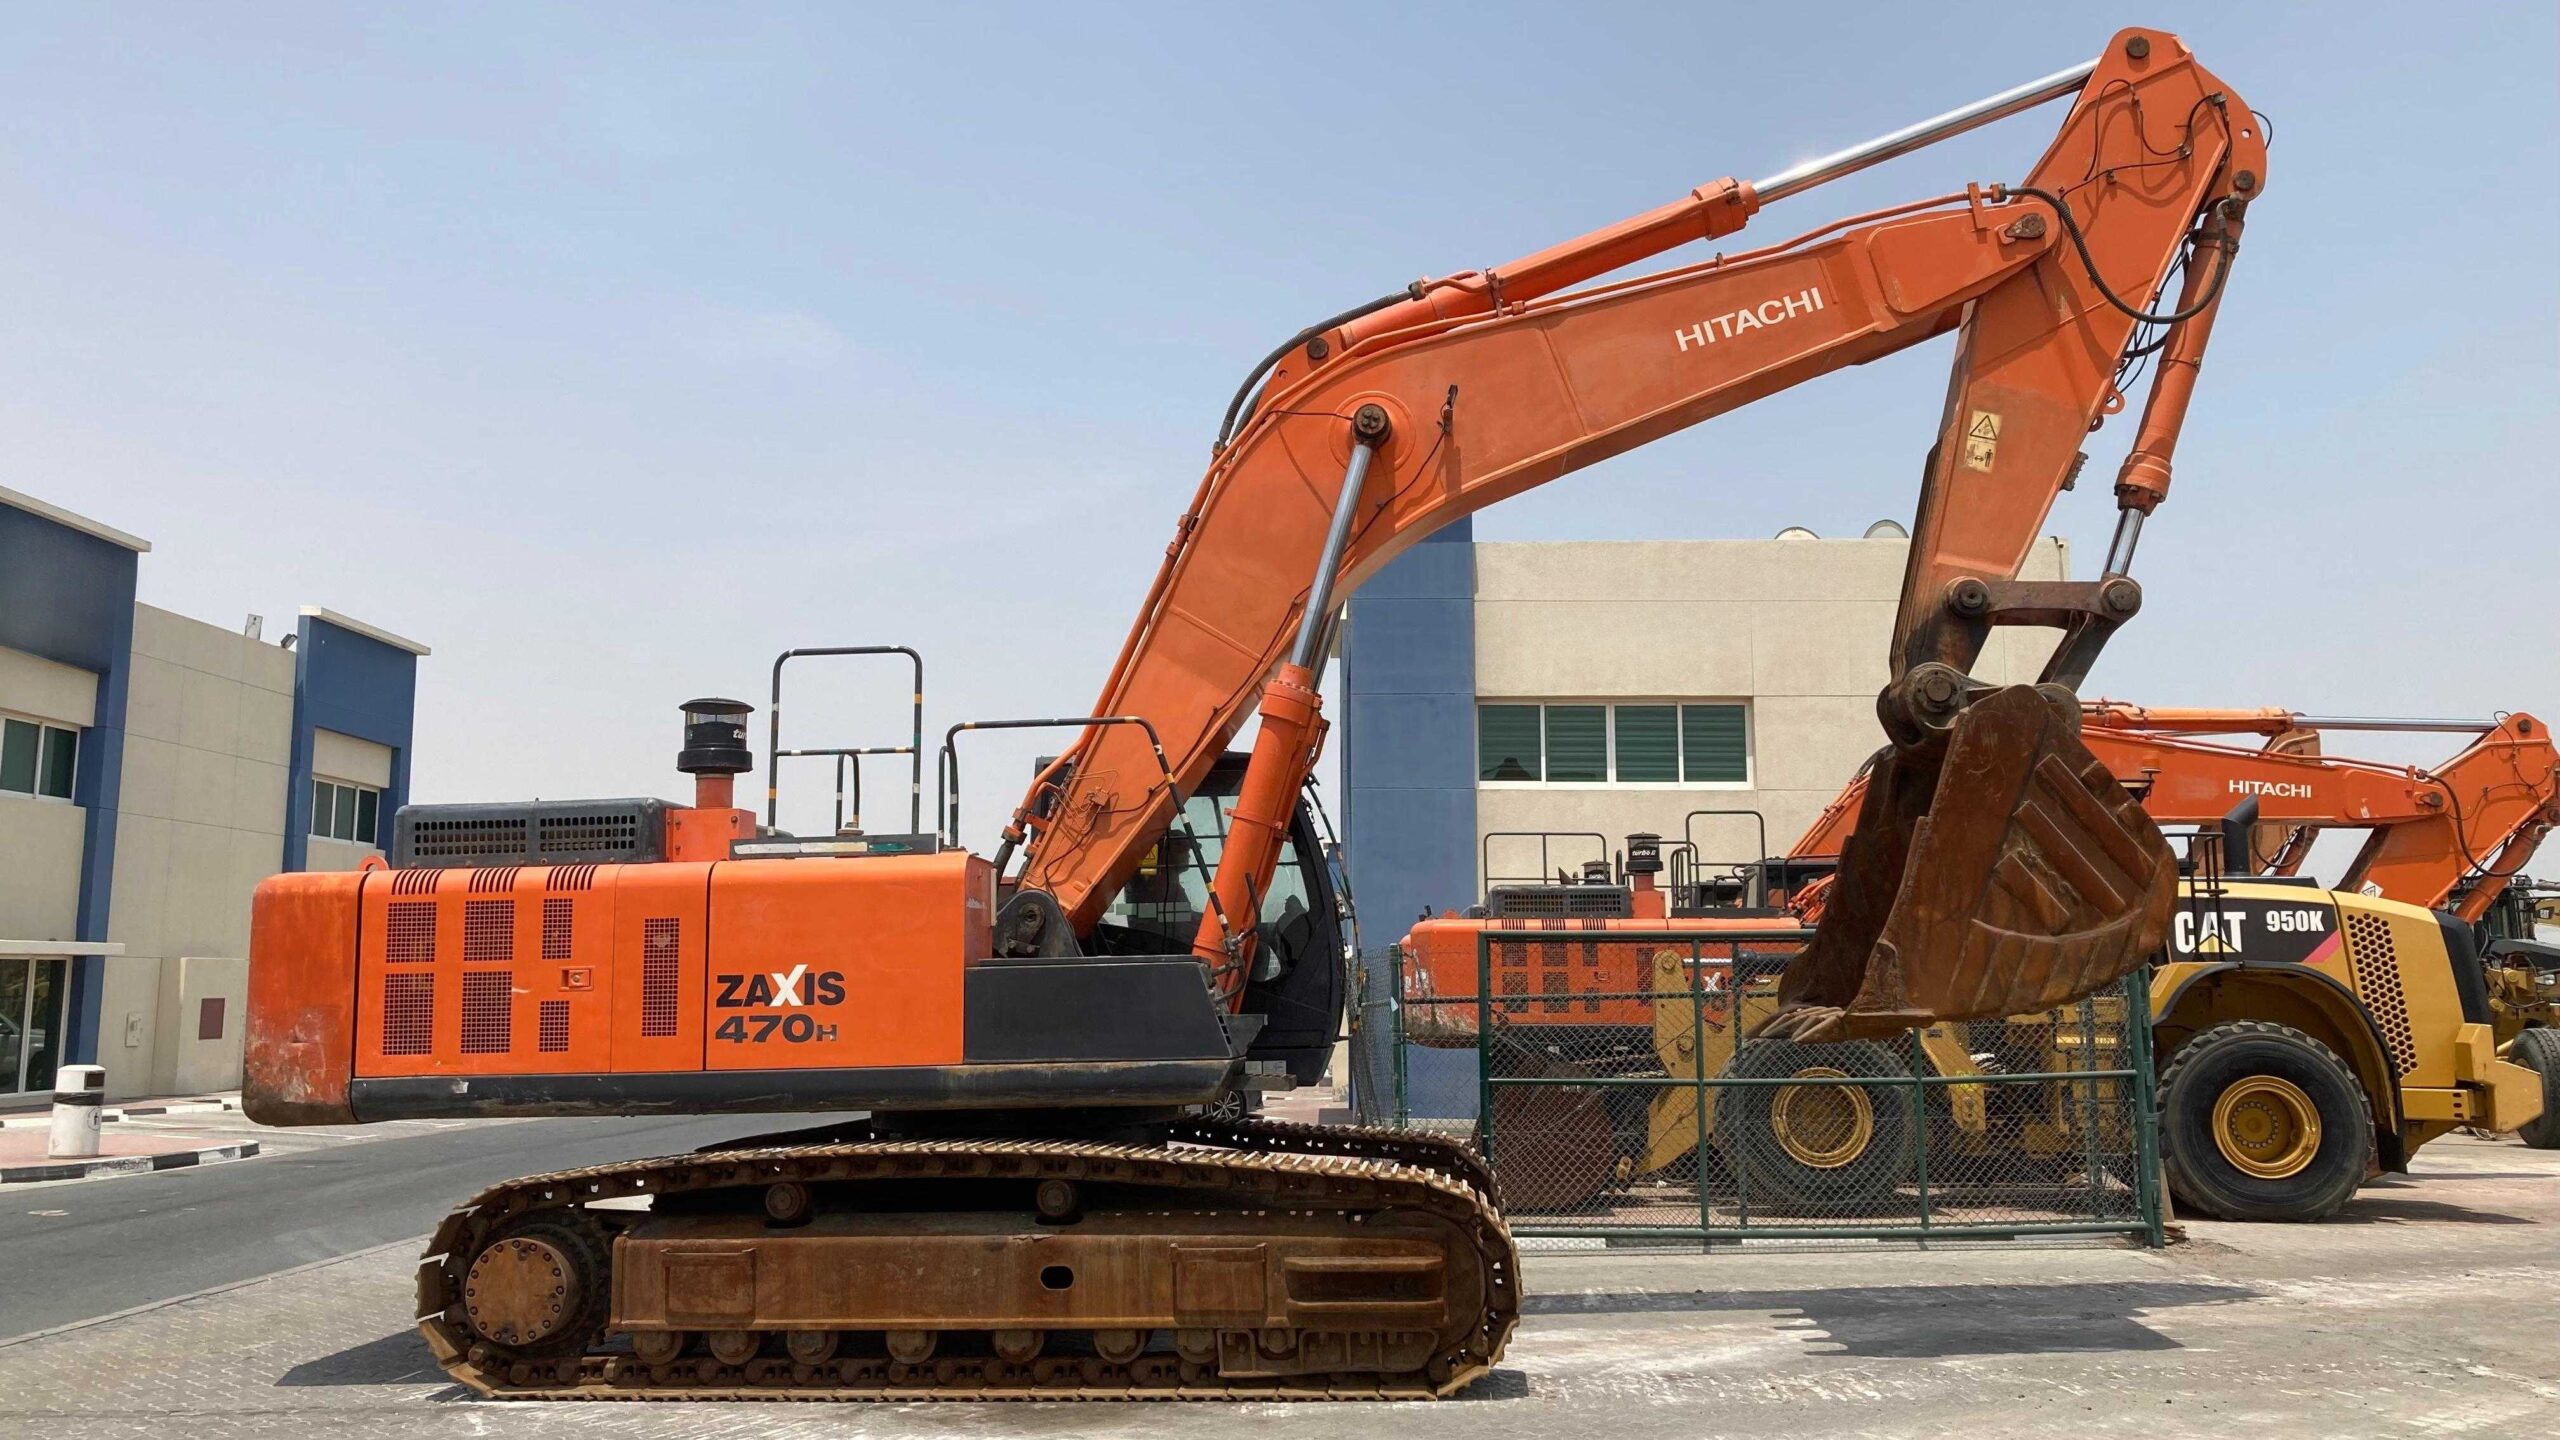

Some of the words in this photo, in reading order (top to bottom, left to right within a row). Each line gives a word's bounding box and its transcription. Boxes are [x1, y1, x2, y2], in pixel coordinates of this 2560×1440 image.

[1675, 287, 1824, 352] HITACHI
[733, 729, 747, 740] tur
[2228, 779, 2312, 798] HITACHI
[2174, 911, 2247, 954] CAT
[2266, 910, 2325, 932] 950K
[716, 964, 846, 1008] ZAXIS
[715, 1013, 837, 1044] 470H
